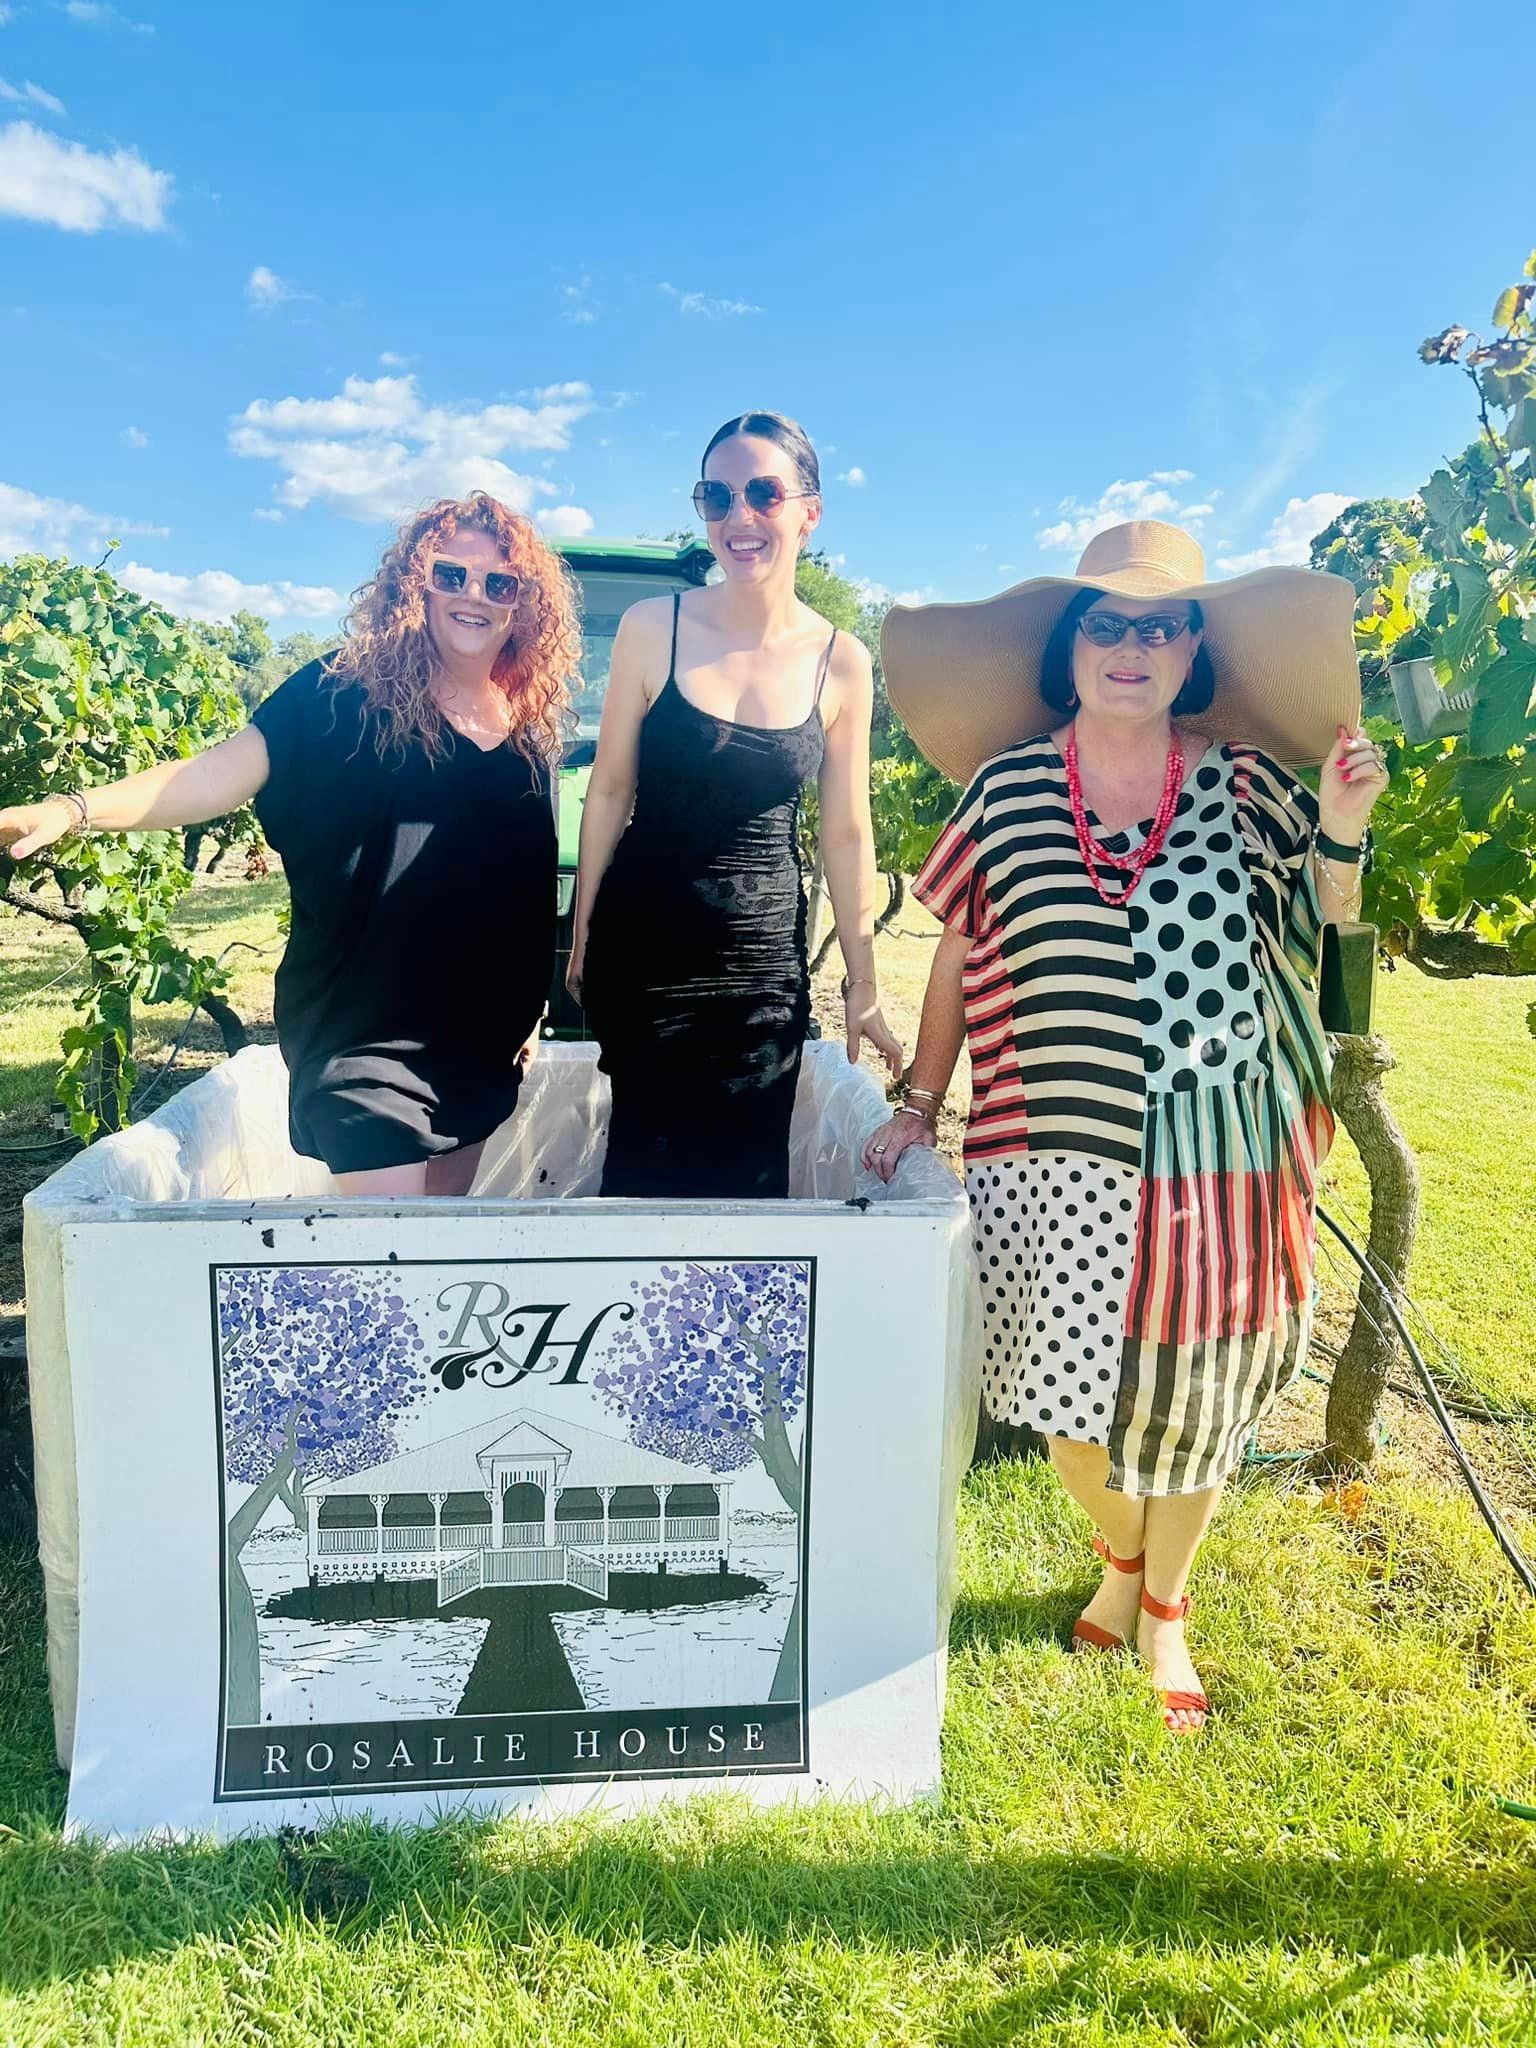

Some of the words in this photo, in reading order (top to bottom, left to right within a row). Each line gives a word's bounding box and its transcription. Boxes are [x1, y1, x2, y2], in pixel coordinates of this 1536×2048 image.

[436, 1281, 635, 1388] RH
[263, 1733, 527, 1775] ROSALIE
[573, 1723, 766, 1760] HOUSE
